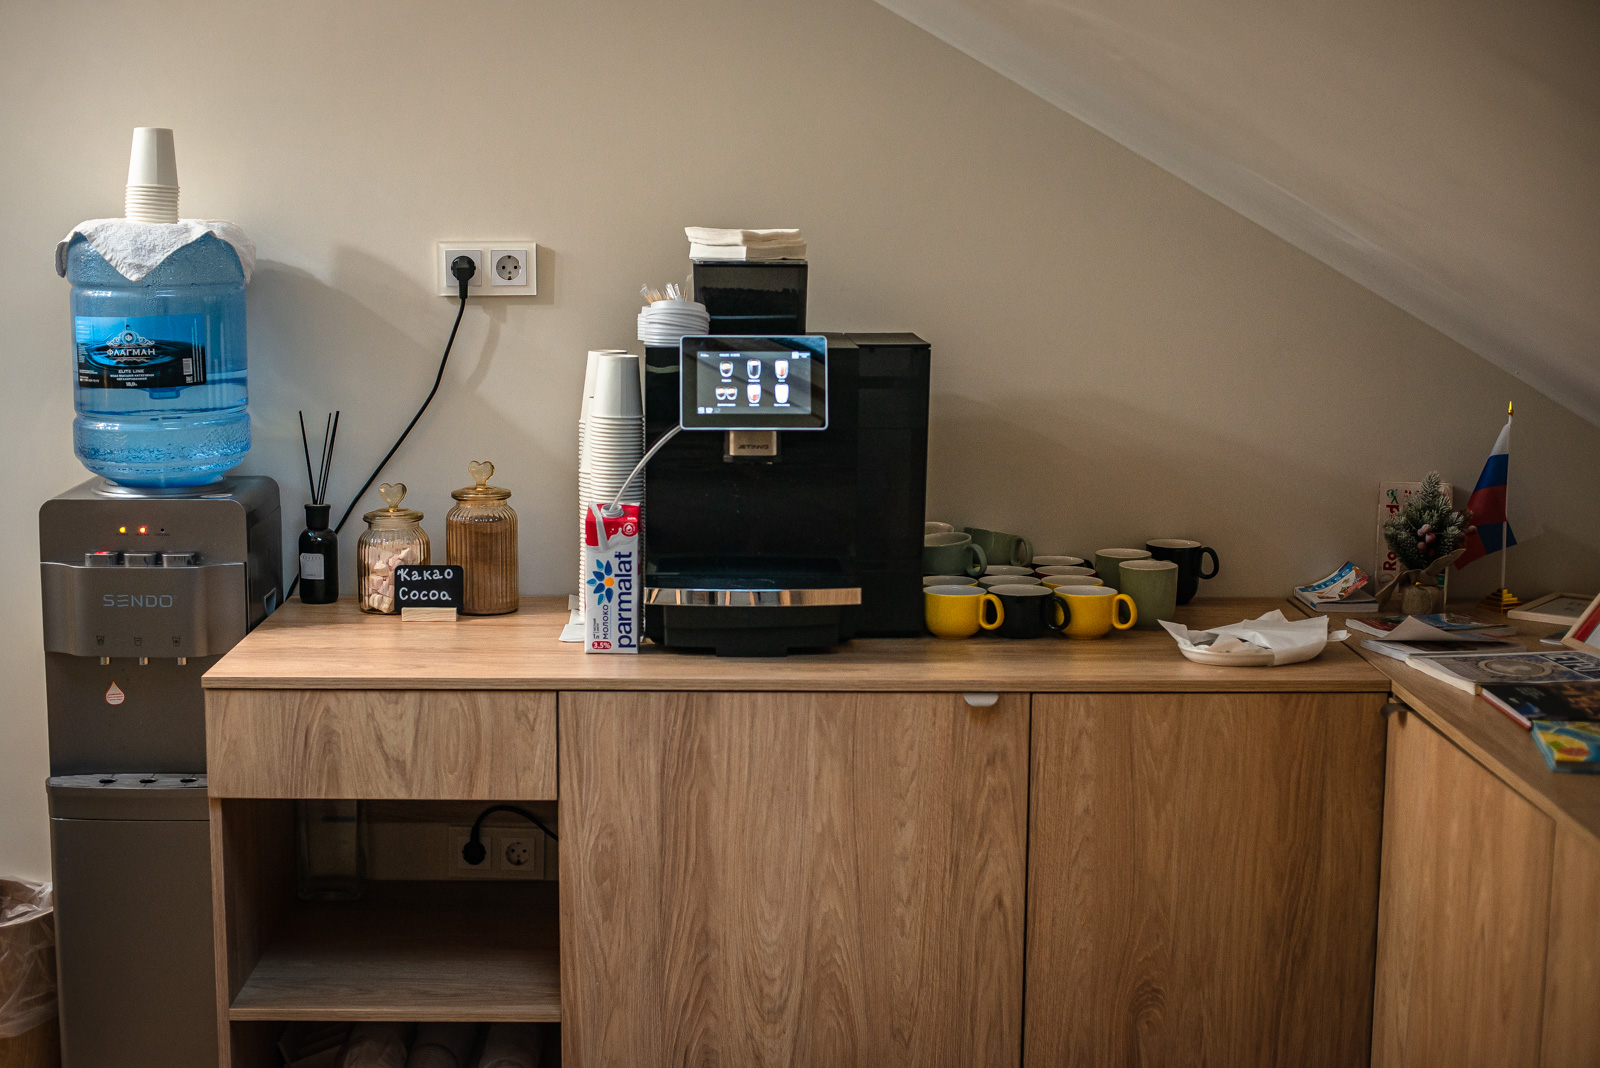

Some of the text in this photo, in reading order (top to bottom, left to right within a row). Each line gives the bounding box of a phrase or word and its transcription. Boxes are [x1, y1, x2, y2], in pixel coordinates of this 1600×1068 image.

[106, 348, 156, 356] ФЛАГМАН
[103, 594, 174, 608] SENDO
[398, 586, 452, 601] Cocoa
[614, 551, 637, 649] parmalat
[602, 604, 610, 640] МОЛОКО
